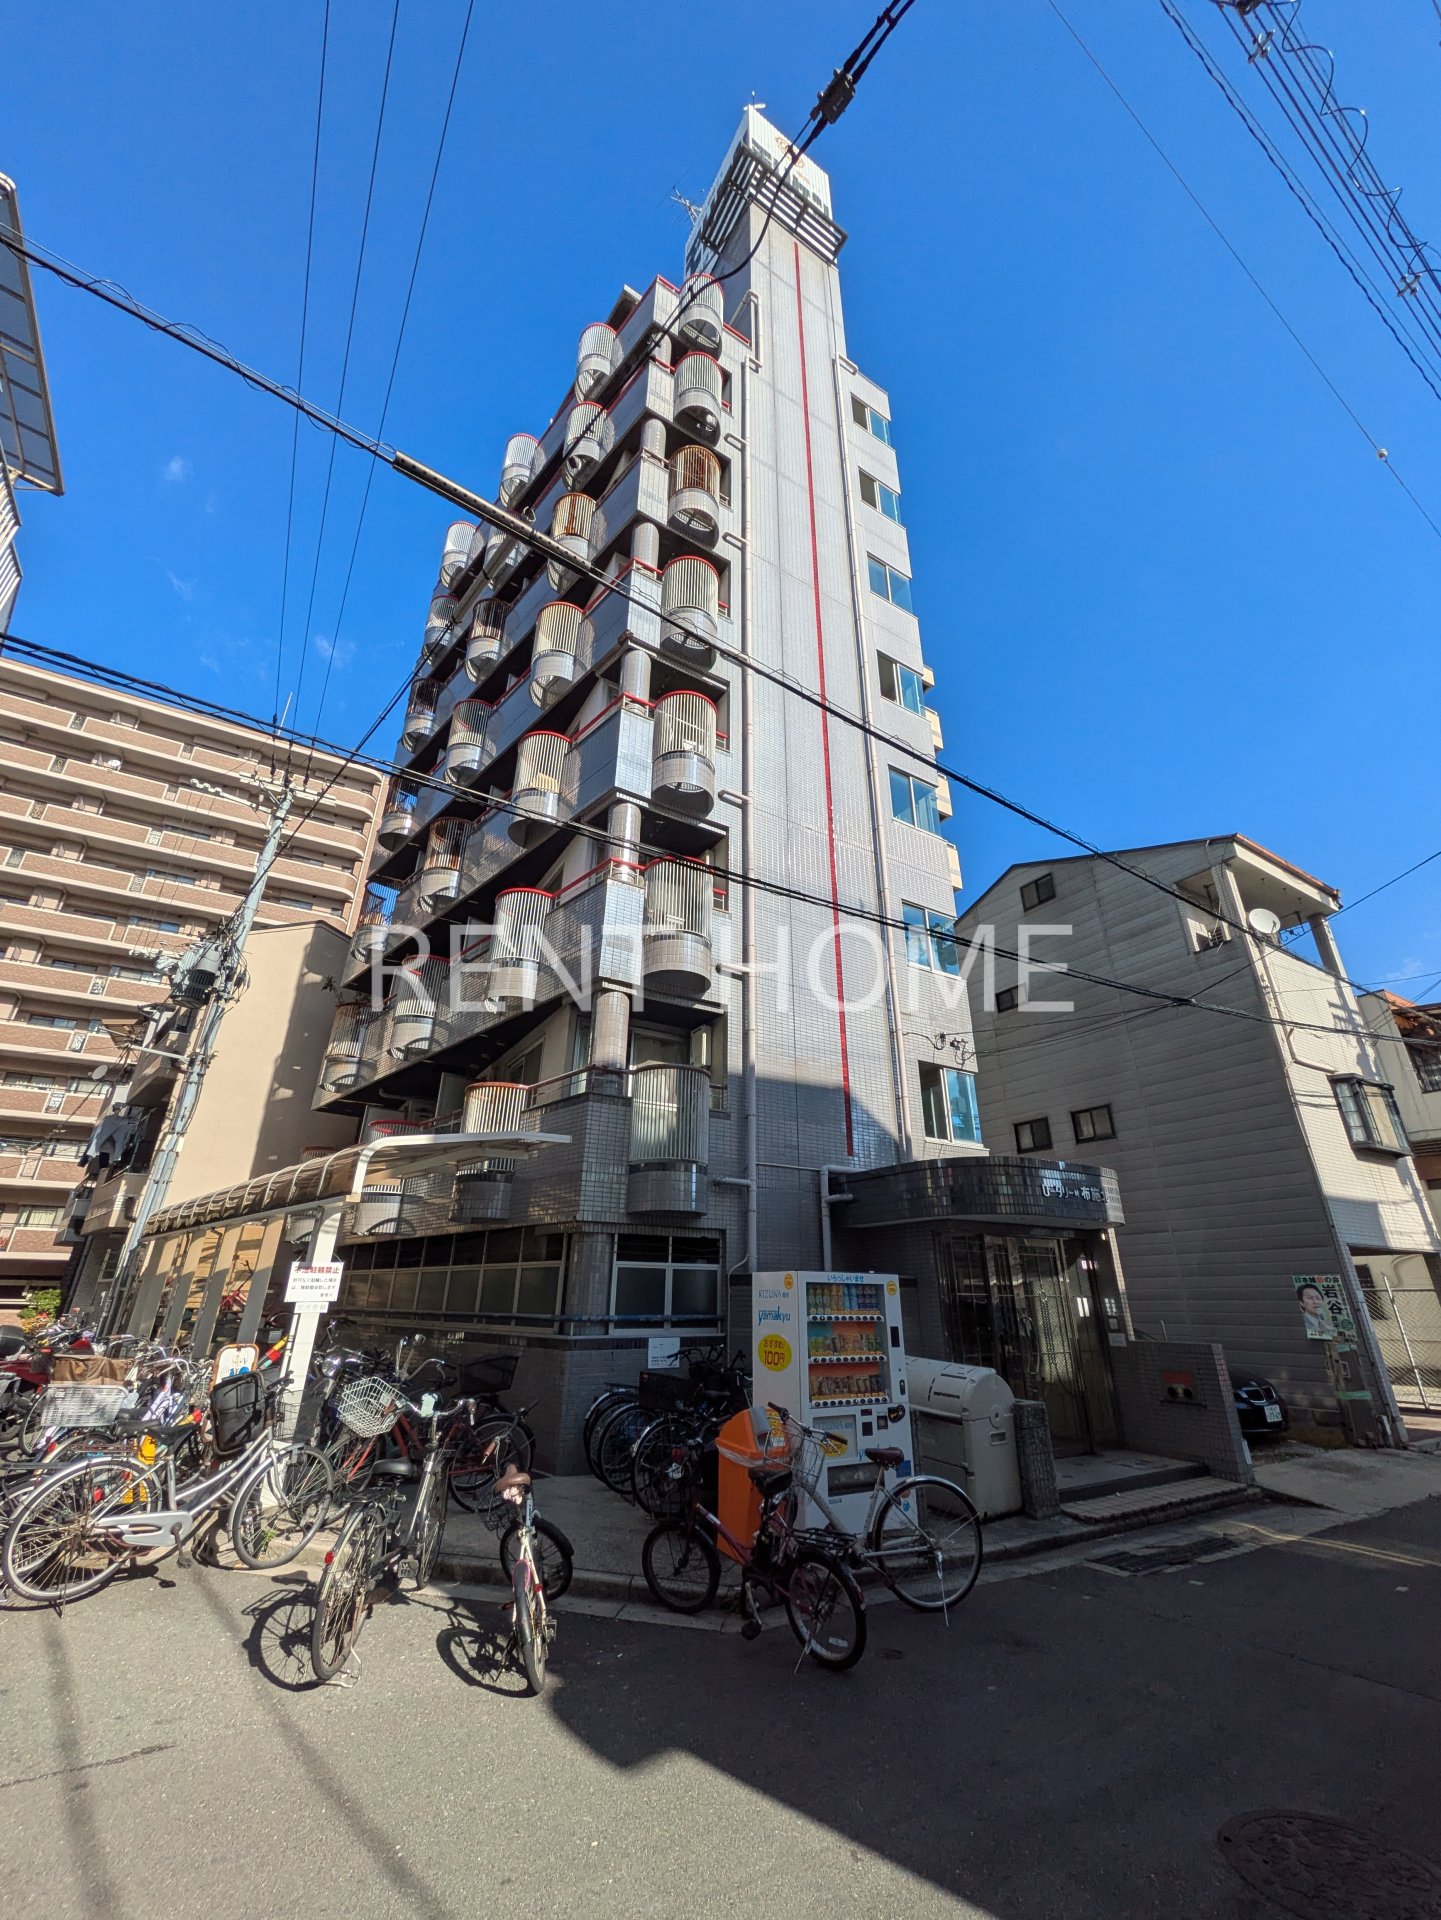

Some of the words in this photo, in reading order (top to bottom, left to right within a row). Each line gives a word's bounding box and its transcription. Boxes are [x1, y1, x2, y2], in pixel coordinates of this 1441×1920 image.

[827, 1274, 865, 1283] いらっしゃいませ
[758, 1306, 791, 1325] yamakyu
